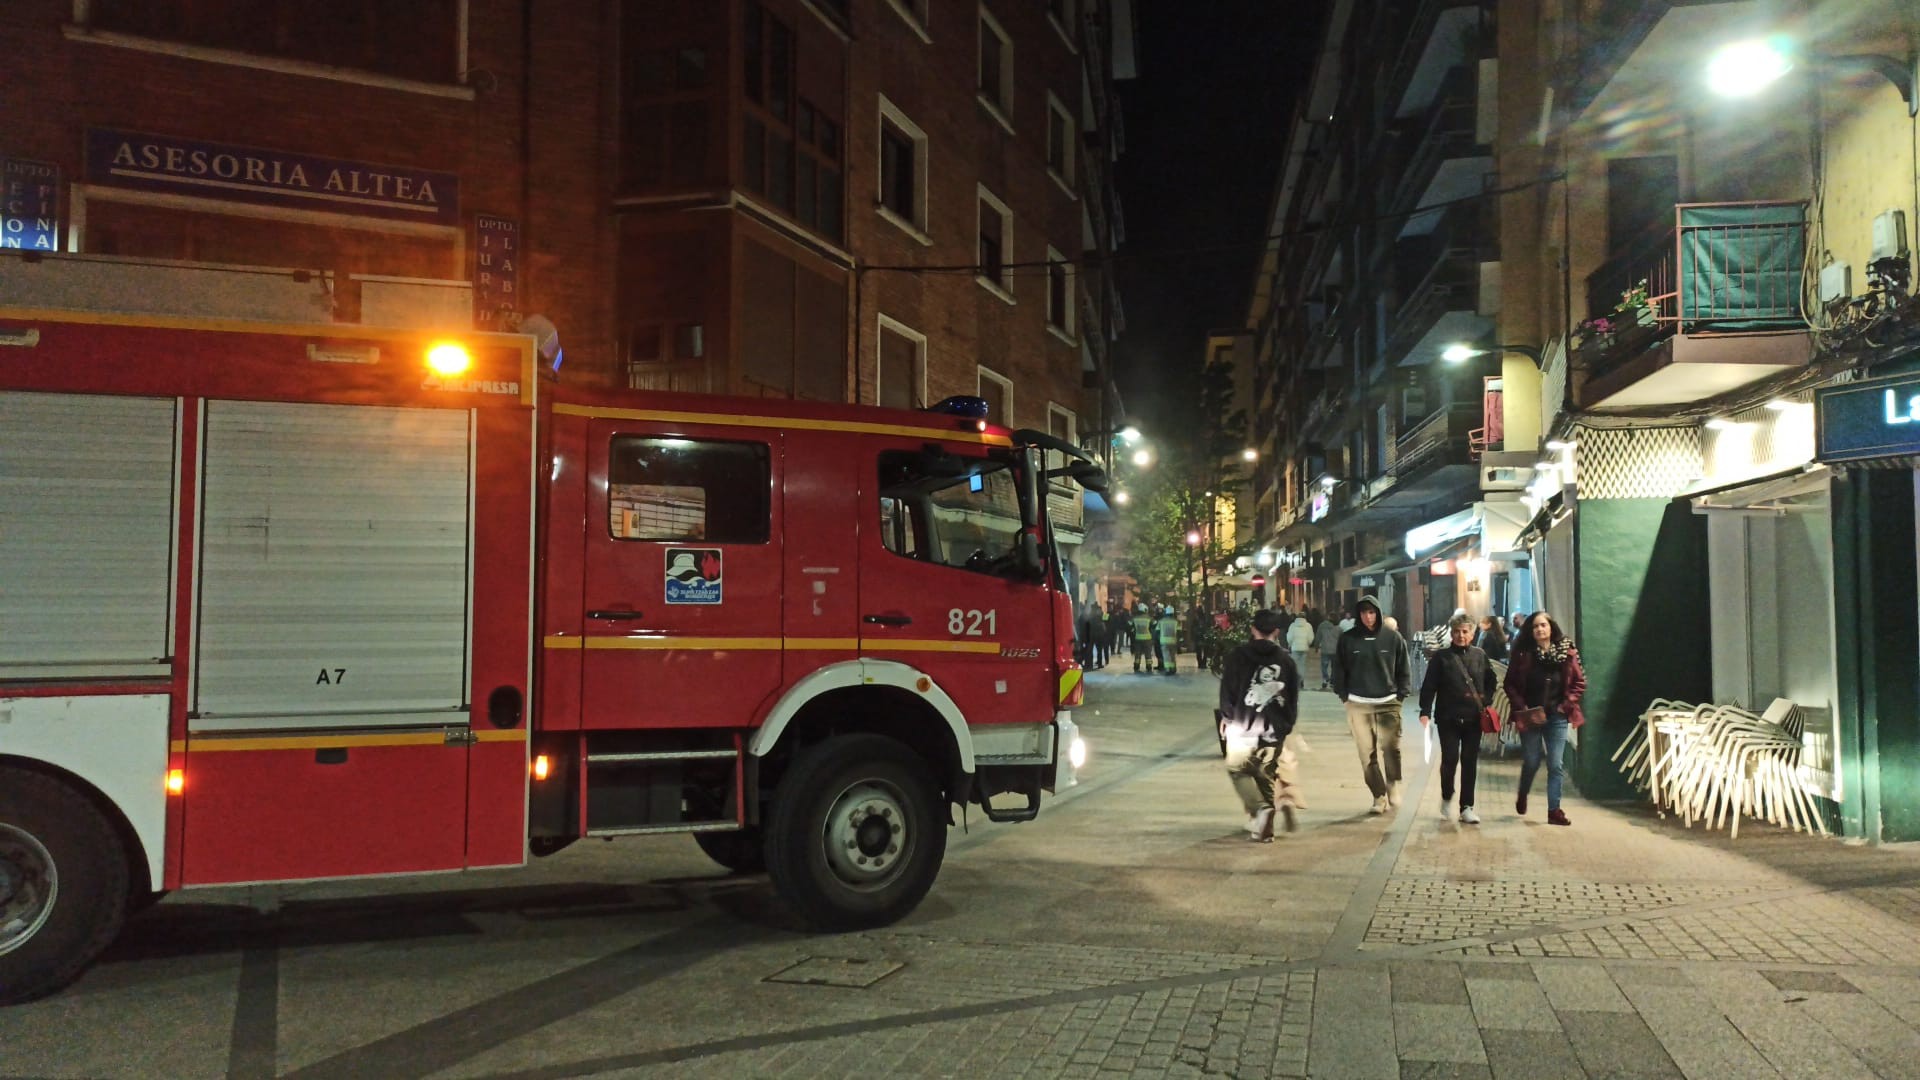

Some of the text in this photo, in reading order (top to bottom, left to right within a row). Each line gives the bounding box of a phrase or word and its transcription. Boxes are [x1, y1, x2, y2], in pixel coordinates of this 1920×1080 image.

[112, 142, 437, 203] ASESORIA ALTEA
[947, 607, 996, 636] 821
